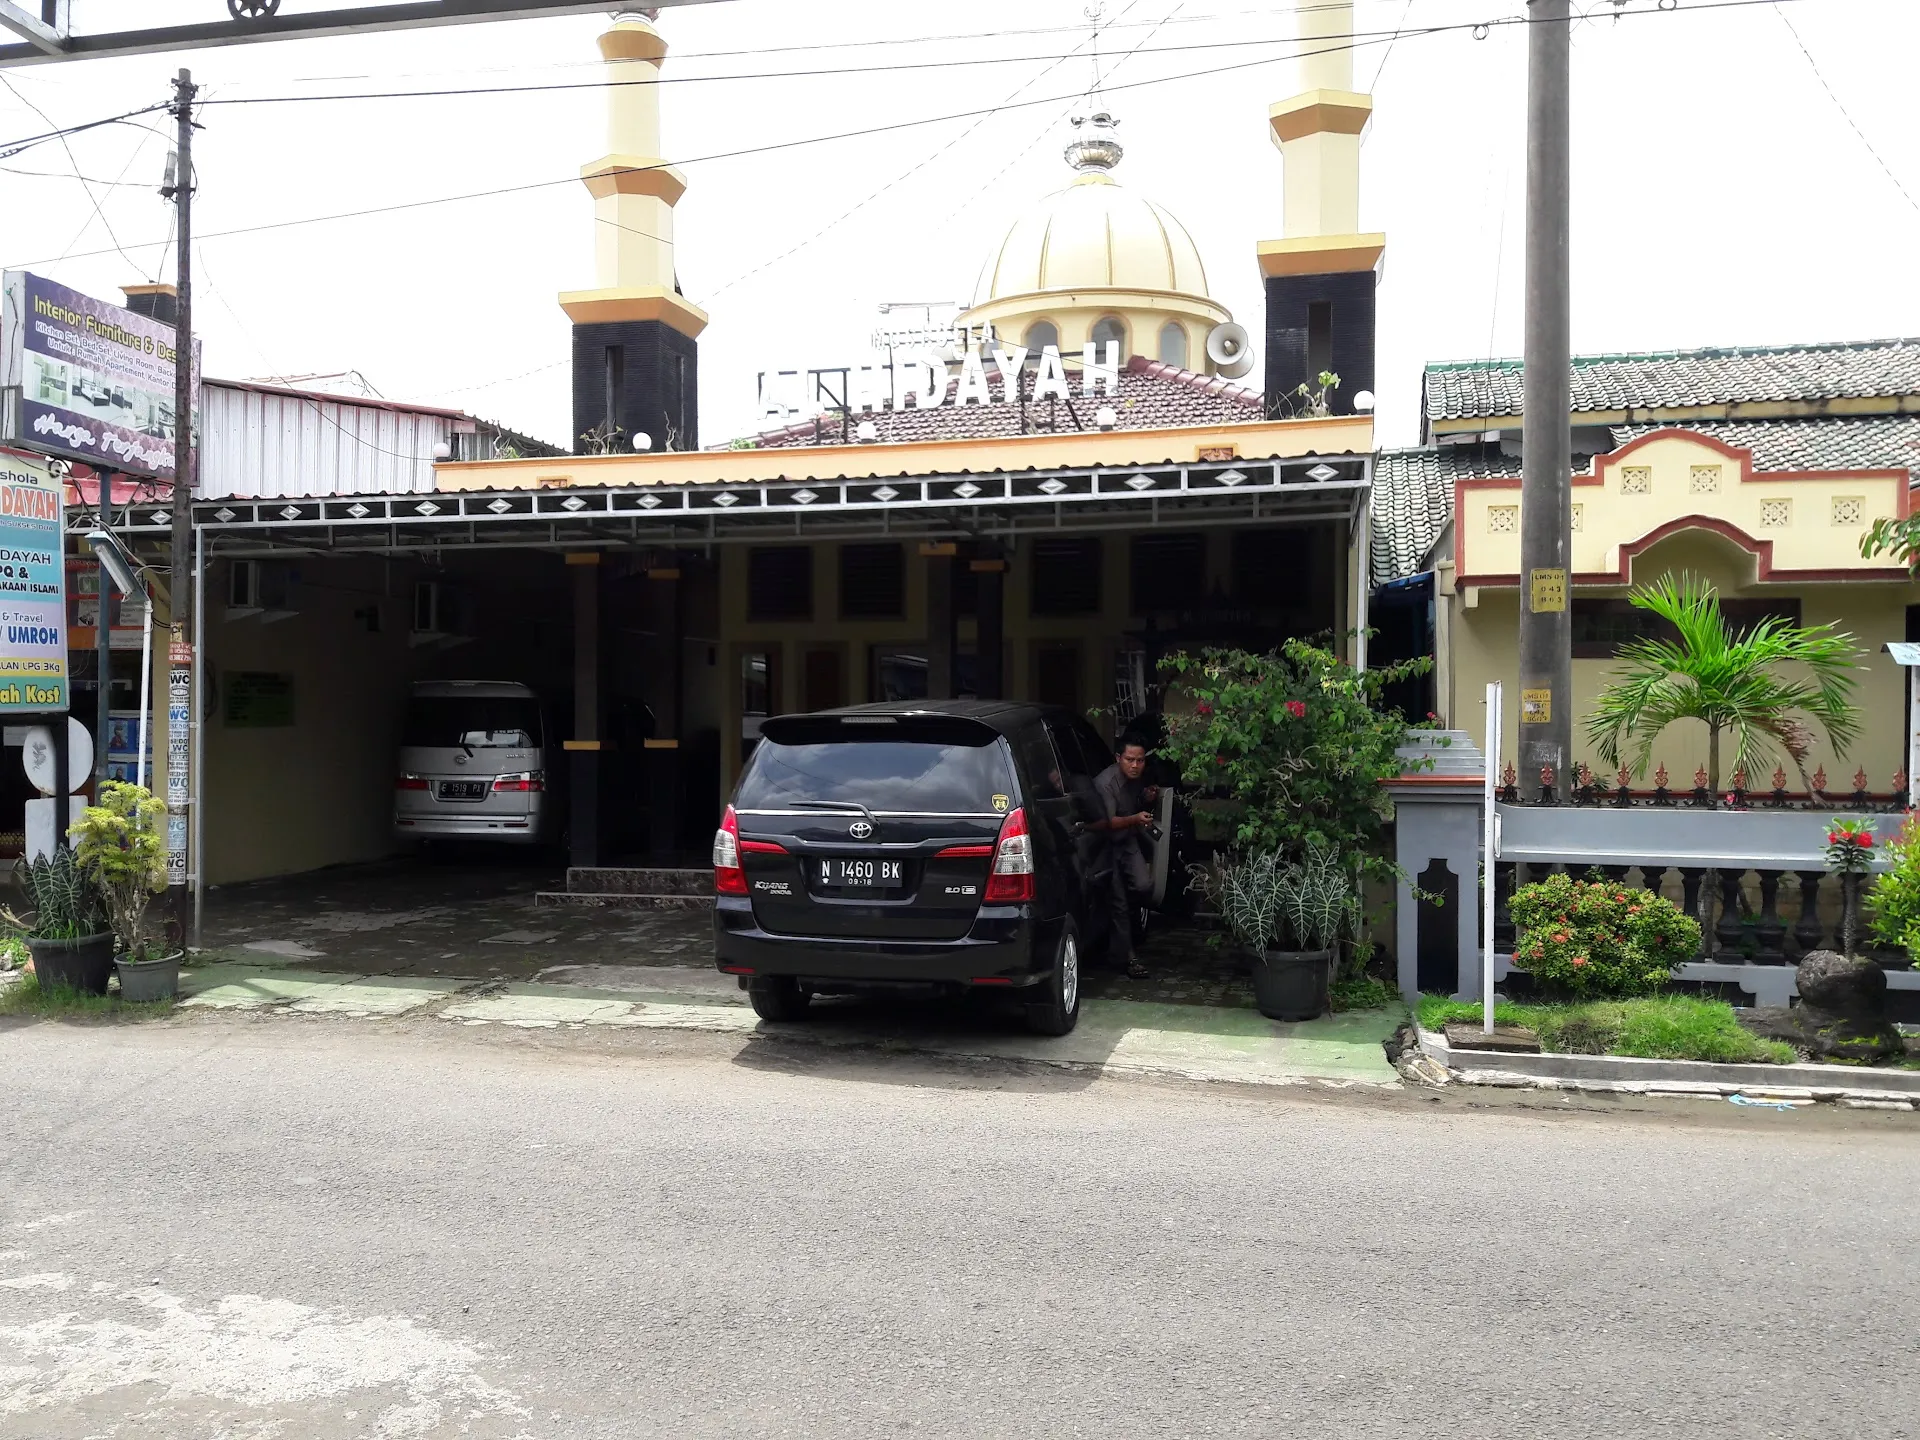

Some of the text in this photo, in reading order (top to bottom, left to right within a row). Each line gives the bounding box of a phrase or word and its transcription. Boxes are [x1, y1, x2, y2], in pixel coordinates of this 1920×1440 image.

[35, 294, 81, 327] Interior
[85, 314, 141, 351] Furniture
[144, 335, 154, 354] &
[36, 320, 64, 340] Kitchen
[114, 350, 133, 366] Living
[148, 373, 170, 388] Kantor
[34, 413, 96, 448] Harga
[18, 567, 29, 579] &
[30, 583, 59, 594] ISLAMI
[3, 611, 43, 622] & Travel
[8, 626, 58, 644] UMROH
[22, 662, 41, 670] LPG
[43, 662, 60, 673] 3Kg
[170, 675, 190, 684] WC
[25, 685, 60, 704] Kost
[170, 710, 189, 720] WC
[169, 778, 189, 787] WC
[822, 860, 900, 879] N 1460 BK
